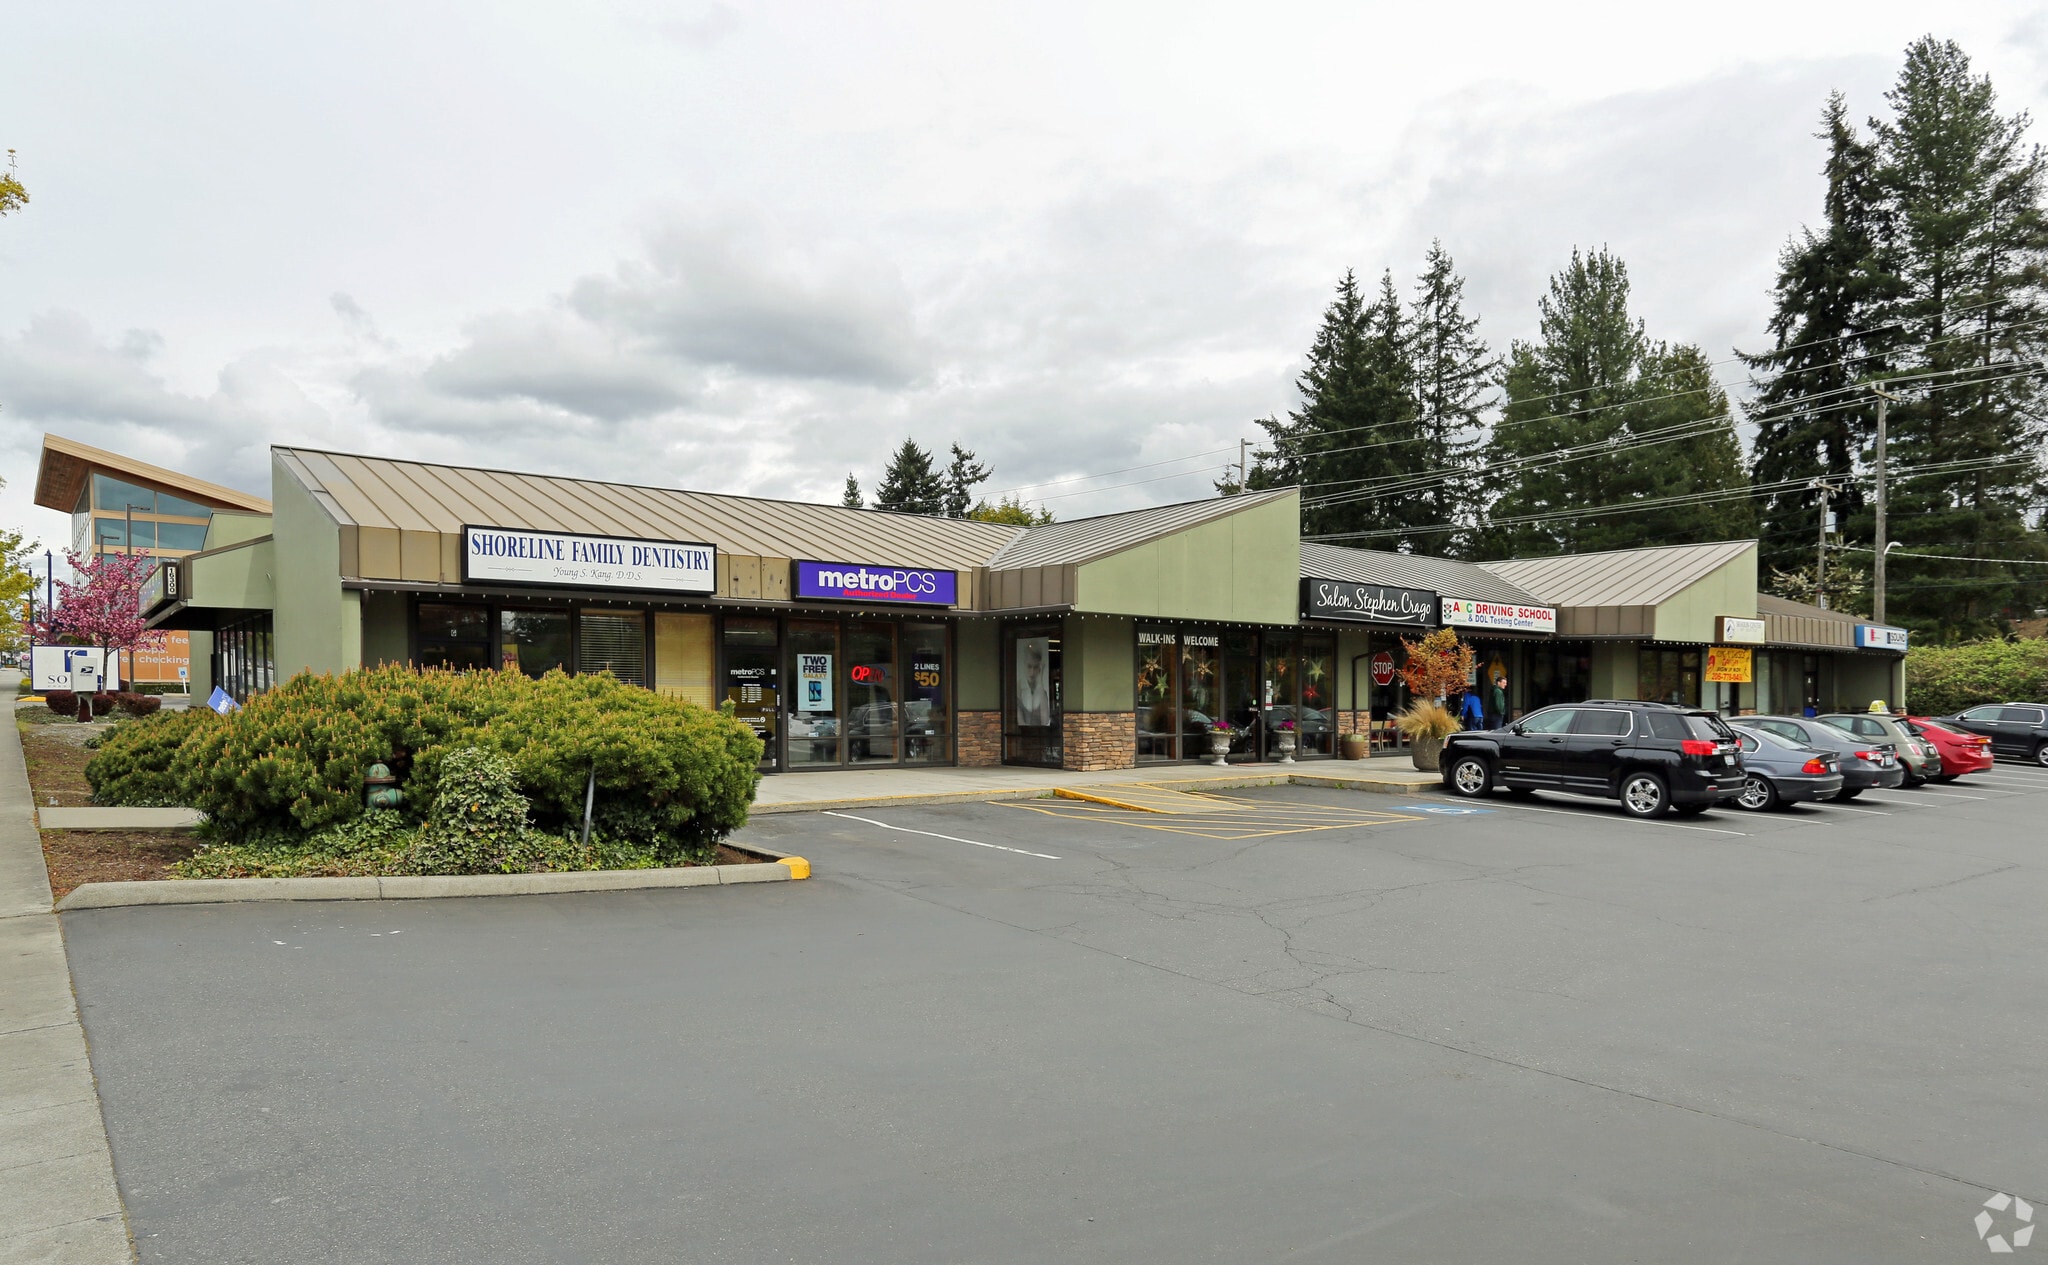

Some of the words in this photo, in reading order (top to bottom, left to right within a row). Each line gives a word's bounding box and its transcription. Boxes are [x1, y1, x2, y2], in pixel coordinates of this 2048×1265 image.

[472, 533, 565, 561] SHORELINE
[572, 541, 625, 565] FAMILY
[632, 545, 711, 571] DENTISTRY
[553, 567, 579, 580] Young
[818, 568, 936, 594] metroPCS
[843, 589, 889, 598] Authorized
[890, 592, 917, 600] Dealer
[1316, 584, 1353, 608] Salon
[1354, 588, 1400, 619] Stephen
[1401, 592, 1431, 622] Crago
[1476, 604, 1514, 617] DRIVING
[1518, 608, 1553, 620] SCHOOL
[1468, 614, 1473, 622] &
[1475, 615, 1488, 623] DOL
[1490, 616, 1513, 627] Testing
[1513, 618, 1534, 627] Center
[1138, 632, 1176, 645] WALK-INS
[1184, 635, 1219, 647] WELCOME
[139, 655, 189, 665] checking
[803, 656, 827, 665] TWO
[730, 668, 766, 676] metroPCS
[803, 665, 827, 674] FREE
[920, 663, 940, 671] LINES
[1373, 662, 1393, 675] STOP
[851, 665, 884, 683] OPEN
[914, 671, 940, 687] $50
